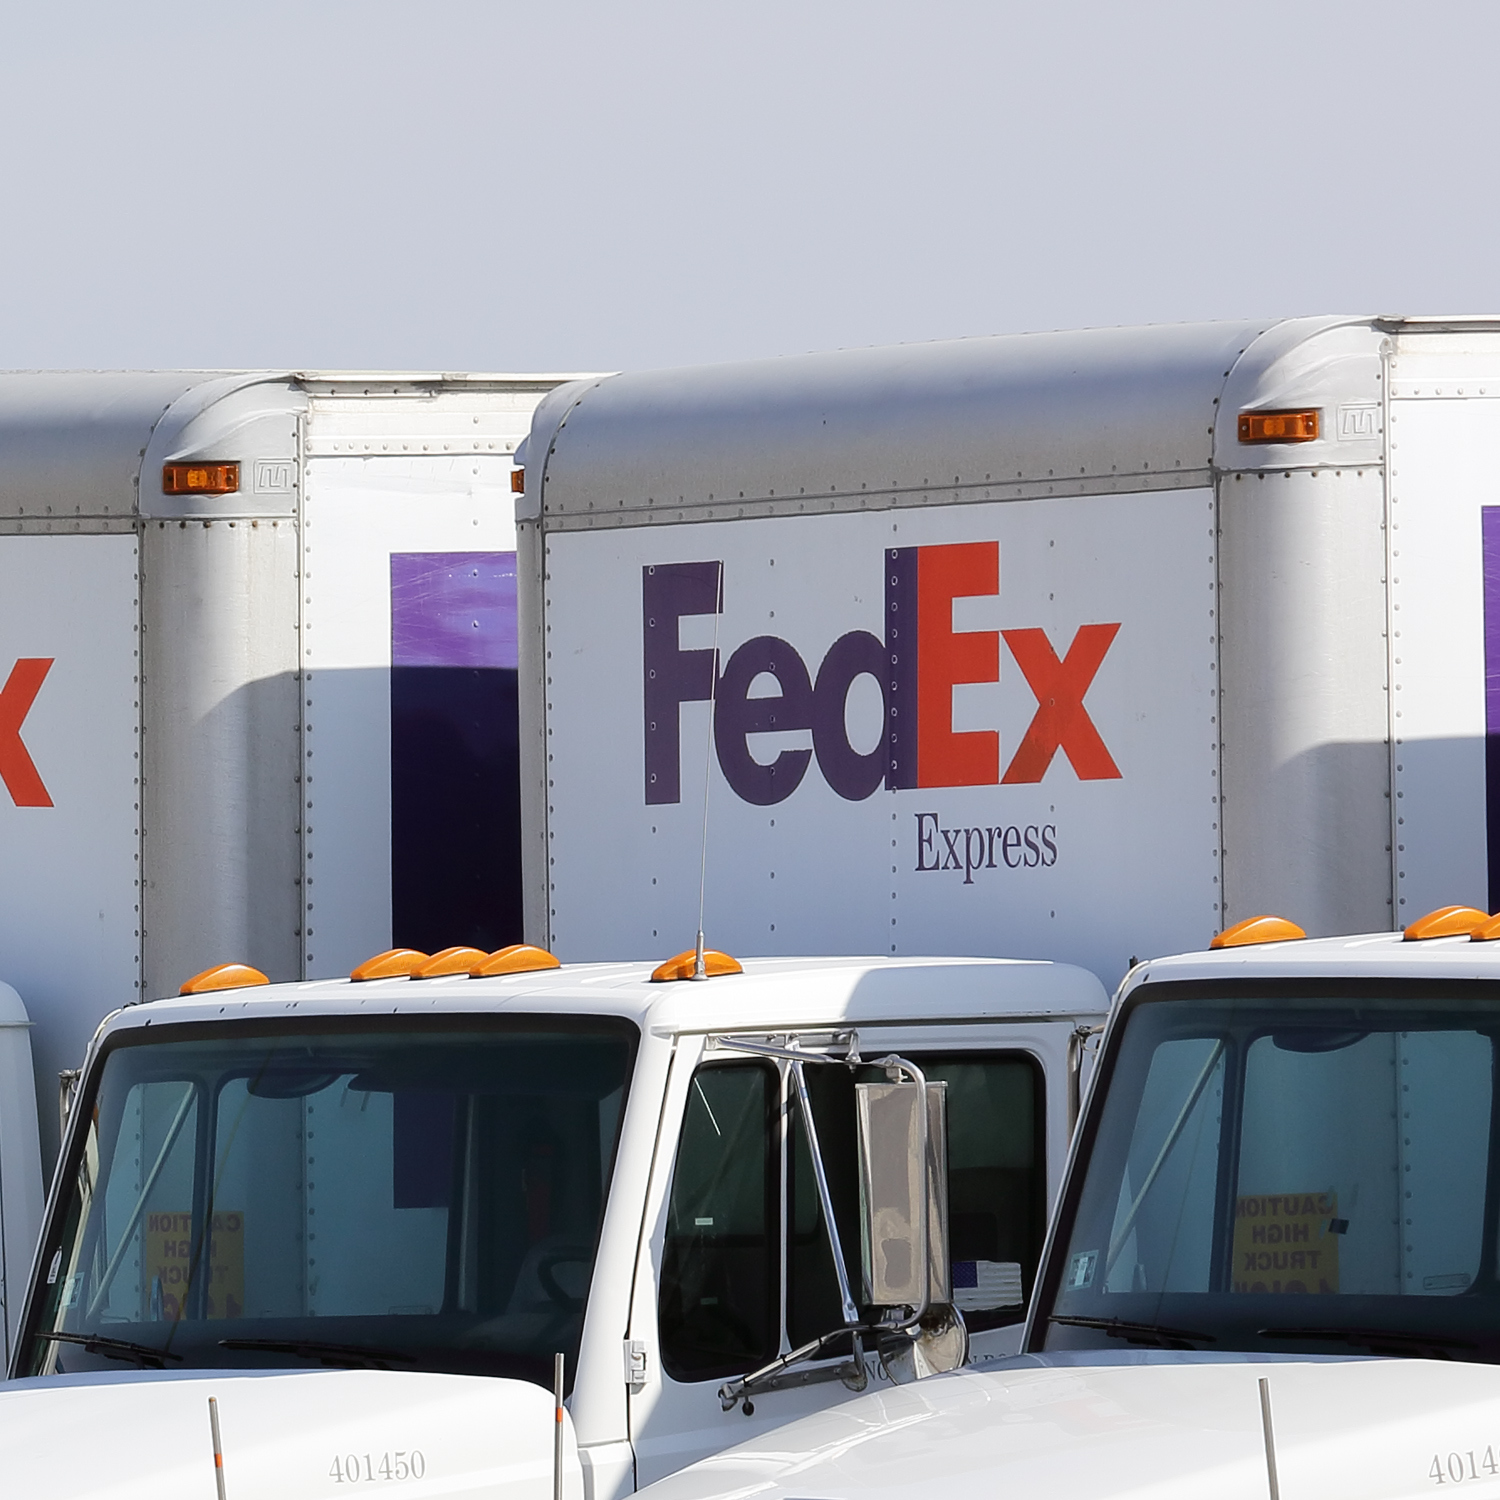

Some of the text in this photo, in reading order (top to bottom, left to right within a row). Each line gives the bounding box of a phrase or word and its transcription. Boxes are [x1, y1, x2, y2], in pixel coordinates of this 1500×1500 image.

[643, 541, 1121, 804] FedEx
[914, 812, 1057, 884] Express
[328, 1450, 426, 1484] 401450
[1428, 1444, 1500, 1485] 4014
